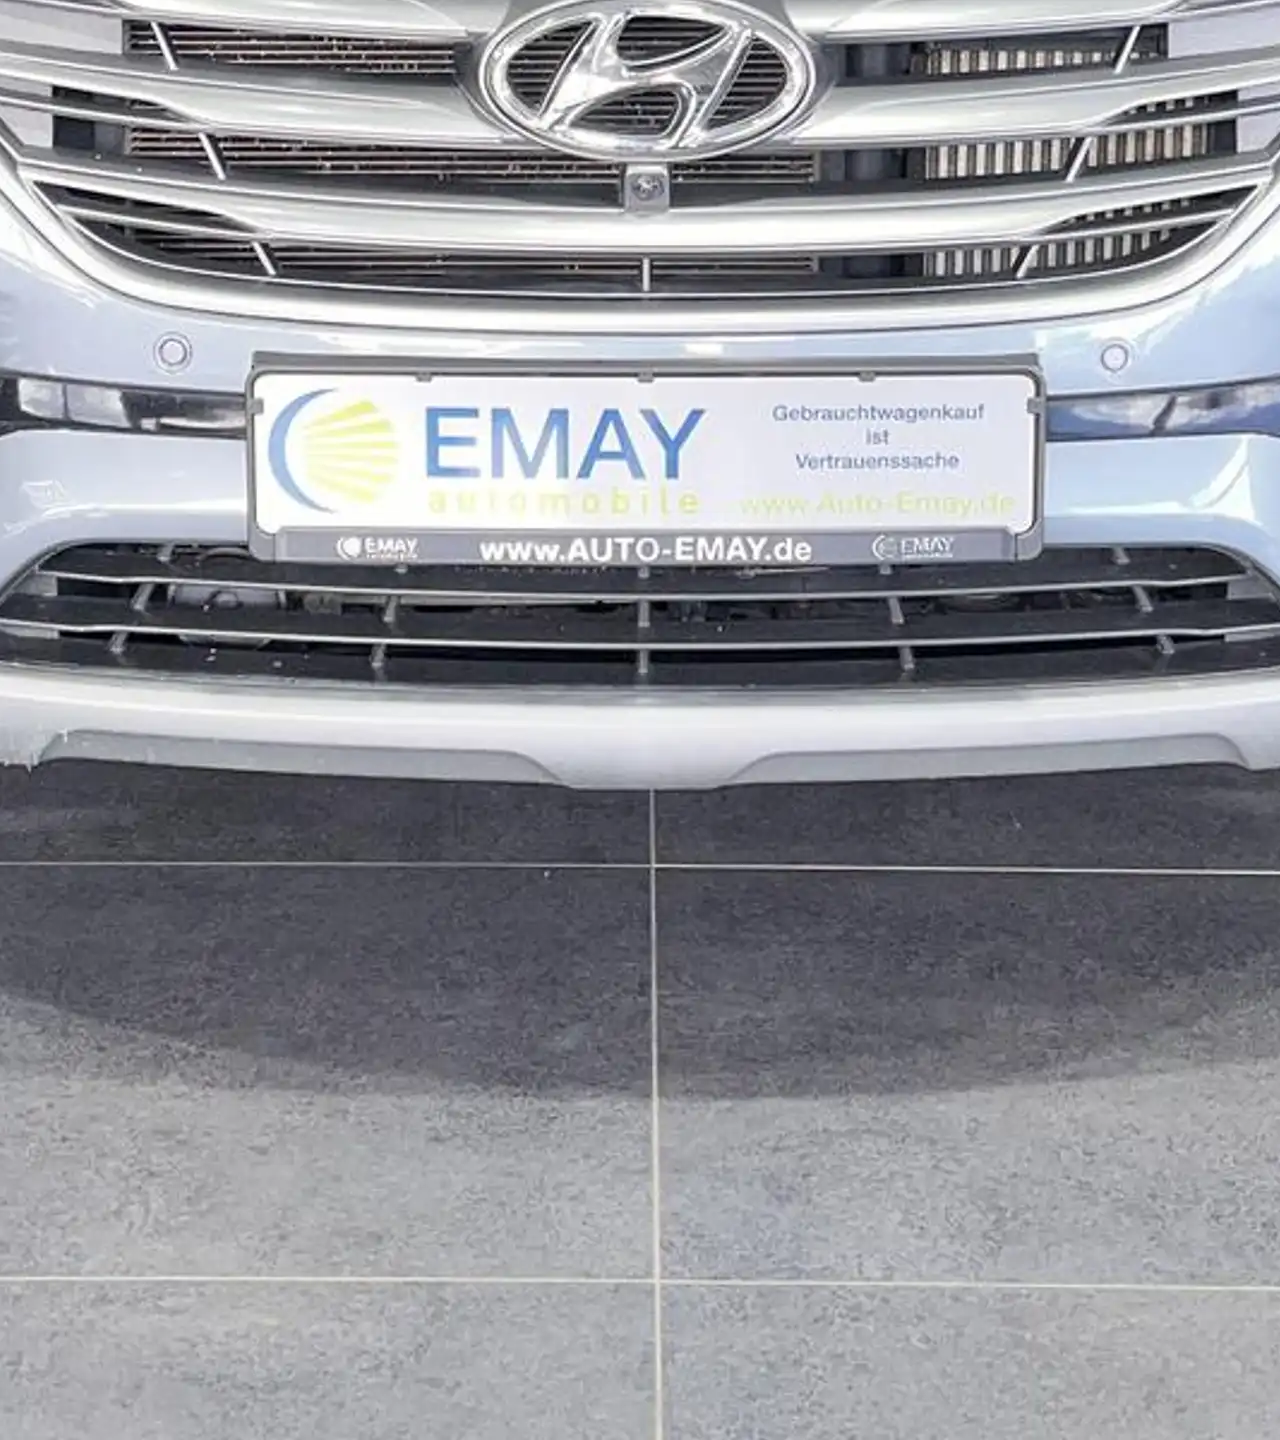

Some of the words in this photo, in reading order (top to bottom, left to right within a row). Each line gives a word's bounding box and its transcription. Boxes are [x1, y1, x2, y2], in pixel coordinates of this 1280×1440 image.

[772, 403, 984, 426] Gebrauchtwagenkauf
[425, 407, 706, 480] EMAY
[865, 427, 889, 446] ist
[795, 453, 960, 471] Vertrauenssache
[428, 488, 701, 515] automobile
[740, 490, 1017, 519] www.Auto-Emay.de
[364, 537, 418, 554] EMAY
[480, 537, 812, 563] www.AUTO-EMAY.de
[901, 537, 955, 554] EMAY
